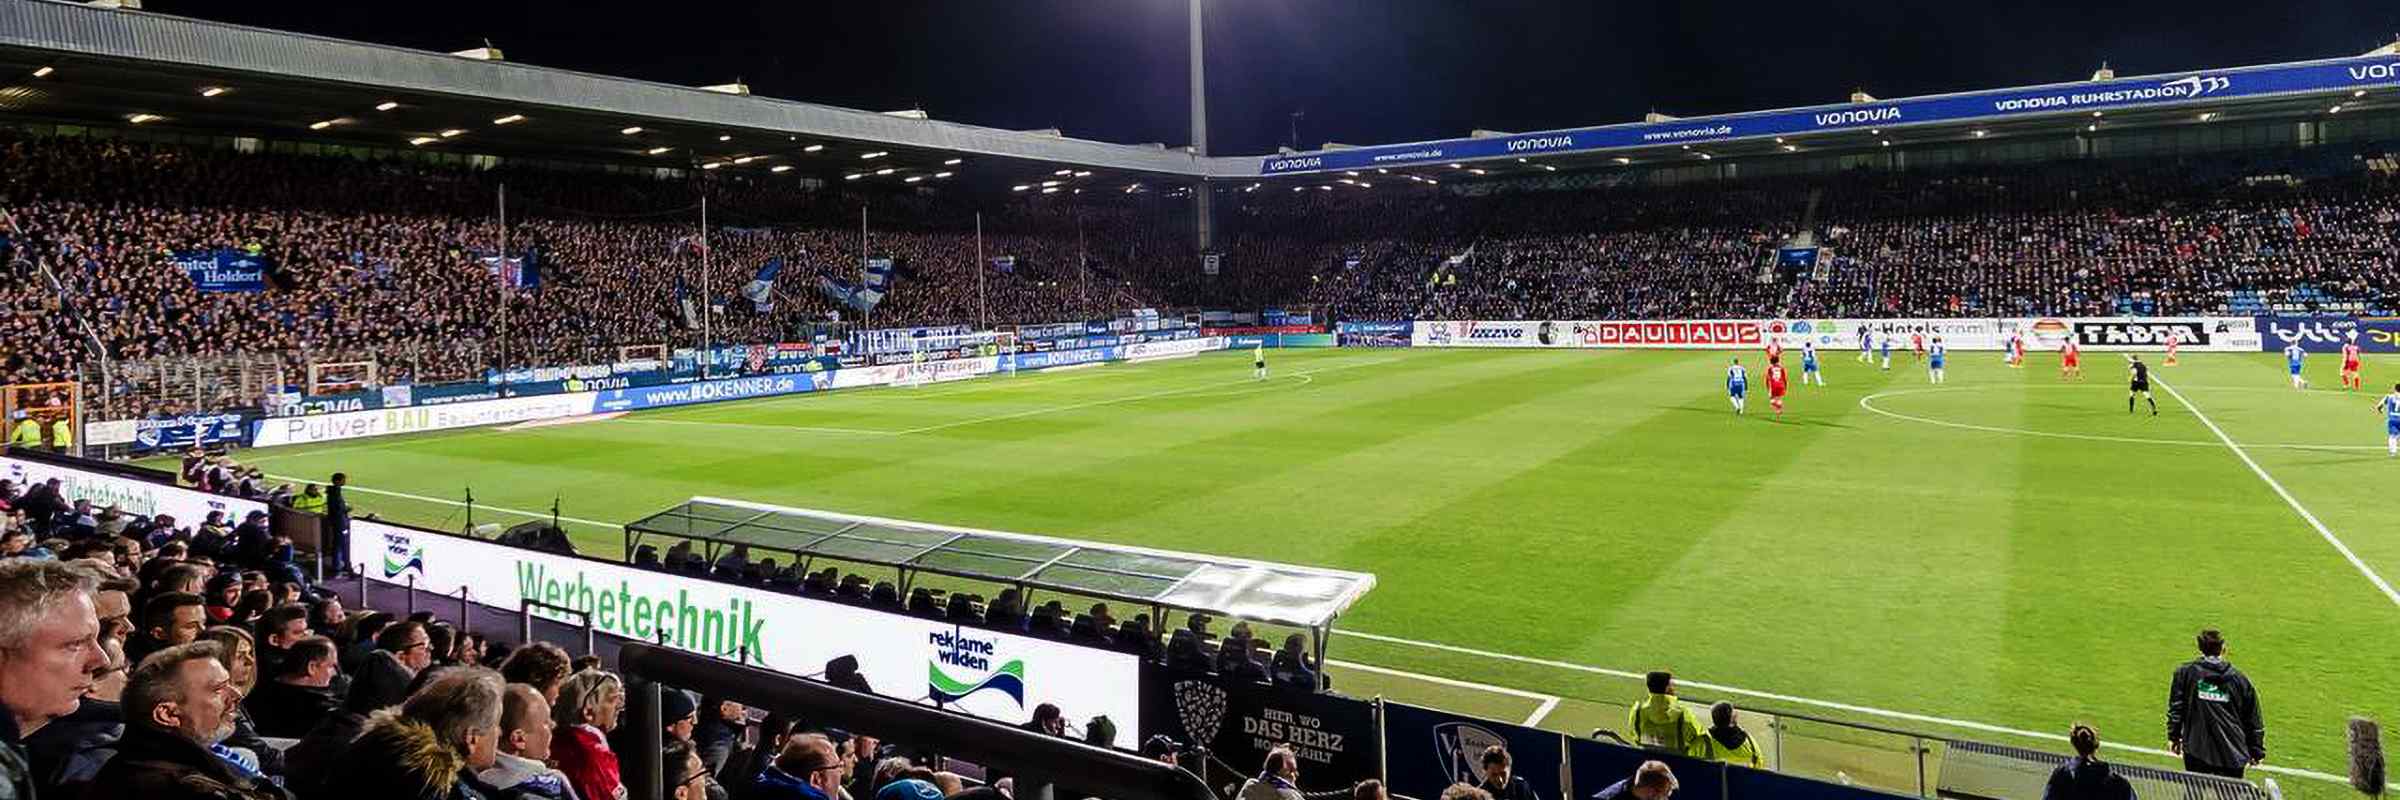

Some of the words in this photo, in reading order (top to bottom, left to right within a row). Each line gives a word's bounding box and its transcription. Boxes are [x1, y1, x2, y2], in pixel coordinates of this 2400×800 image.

[1995, 95, 2067, 111] VONOVIA
[2071, 84, 2188, 104] RUHRSTADION
[1815, 107, 1902, 127] VONOVIA
[1644, 125, 1733, 141] www.vonovia.de
[1507, 136, 1572, 152] VONOVIA
[1270, 157, 1321, 170] VONOVIA
[175, 257, 219, 271] nited
[286, 413, 377, 442] Pulver
[385, 407, 430, 432] BAU
[517, 559, 768, 665] Werbetechnik
[929, 624, 994, 655] reklame
[938, 648, 989, 671] wilden
[1299, 714, 1321, 728] WO
[1243, 716, 1285, 741] DAS
[1288, 725, 1344, 752] HERZ
